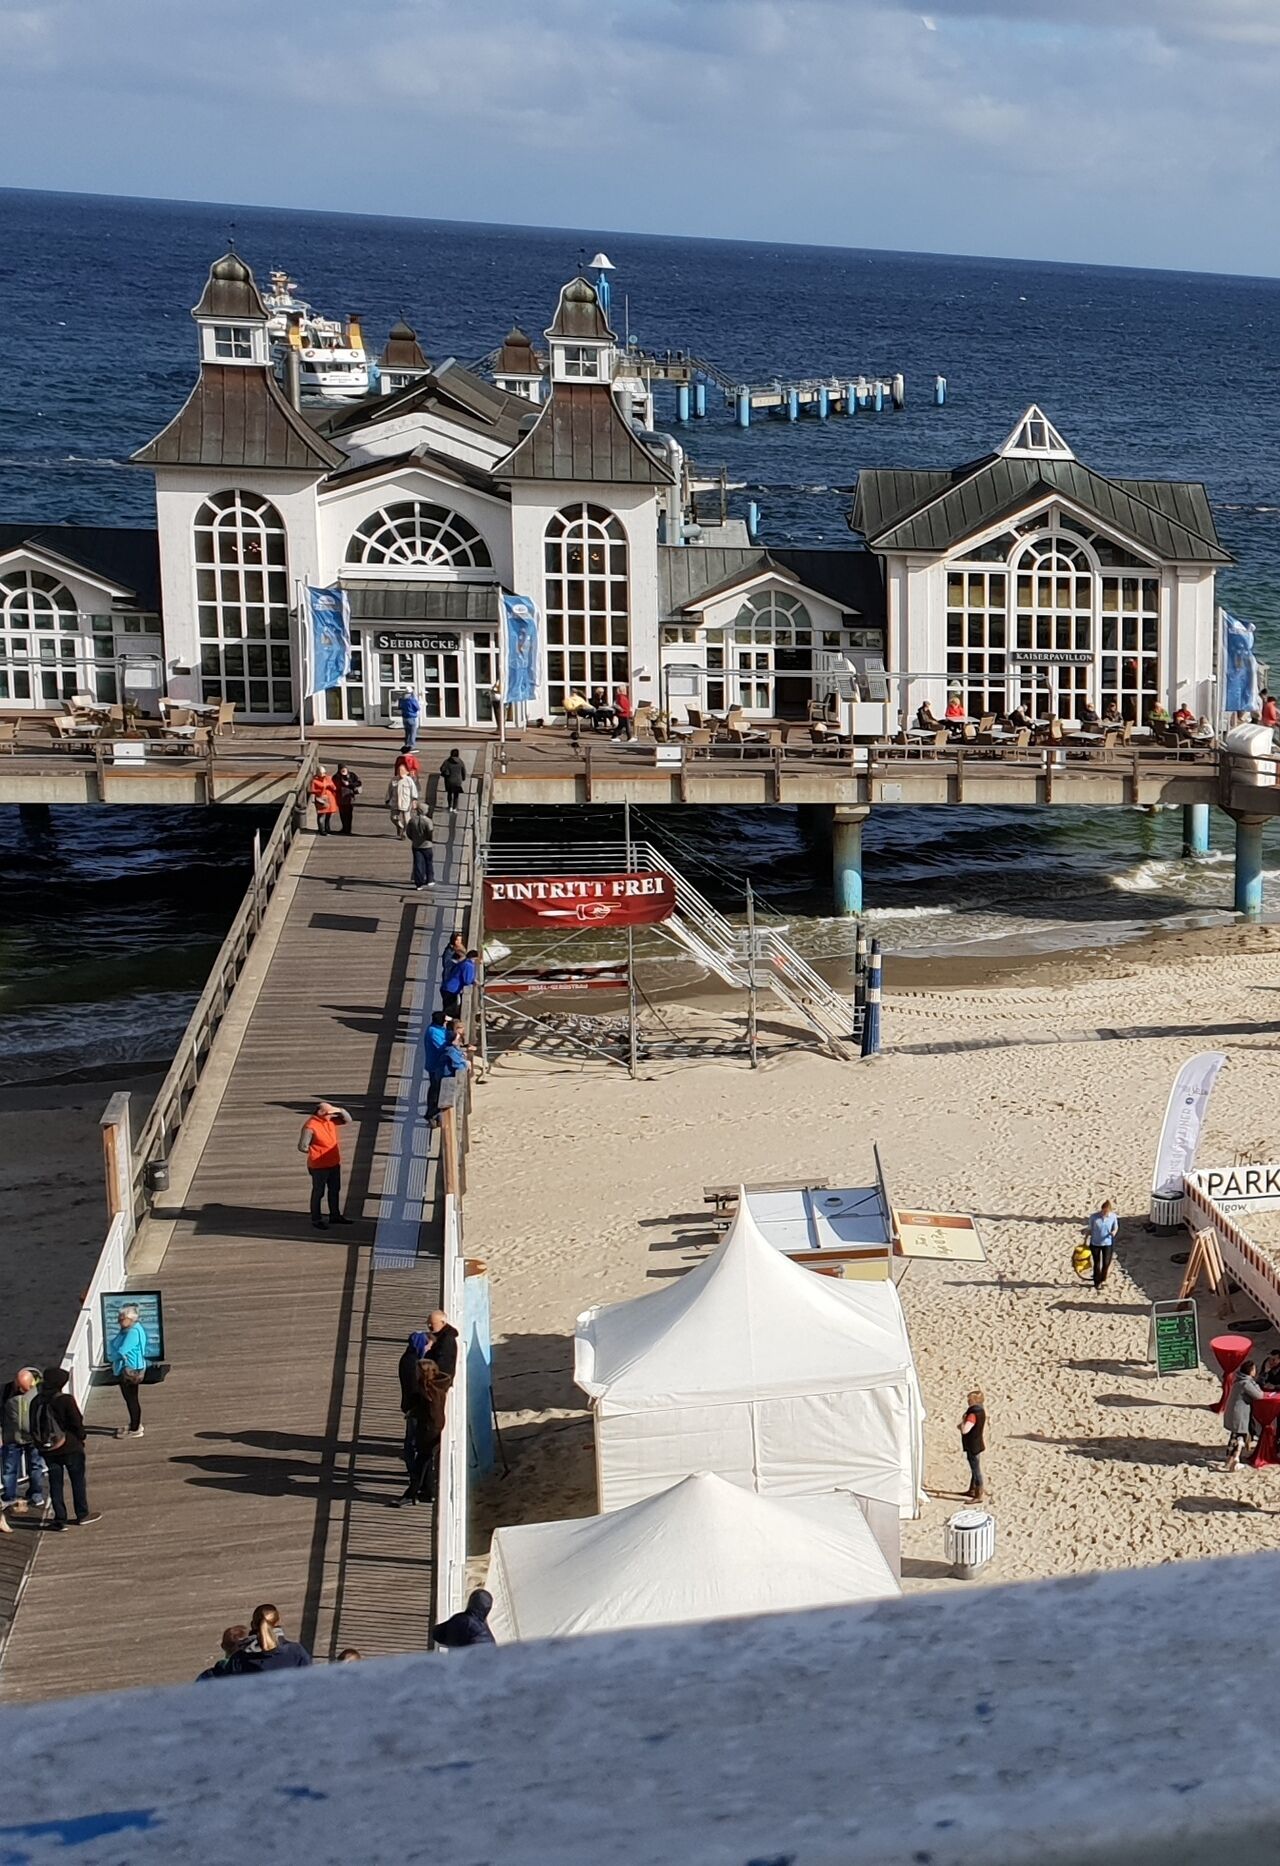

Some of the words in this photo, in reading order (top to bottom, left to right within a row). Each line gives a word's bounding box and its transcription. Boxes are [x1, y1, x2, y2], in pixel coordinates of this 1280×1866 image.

[379, 636, 455, 649] SEEBRÜCKE
[1016, 652, 1093, 661] KAISERPAVILLON
[491, 880, 607, 900] EINTRITT
[612, 877, 665, 897] FREI
